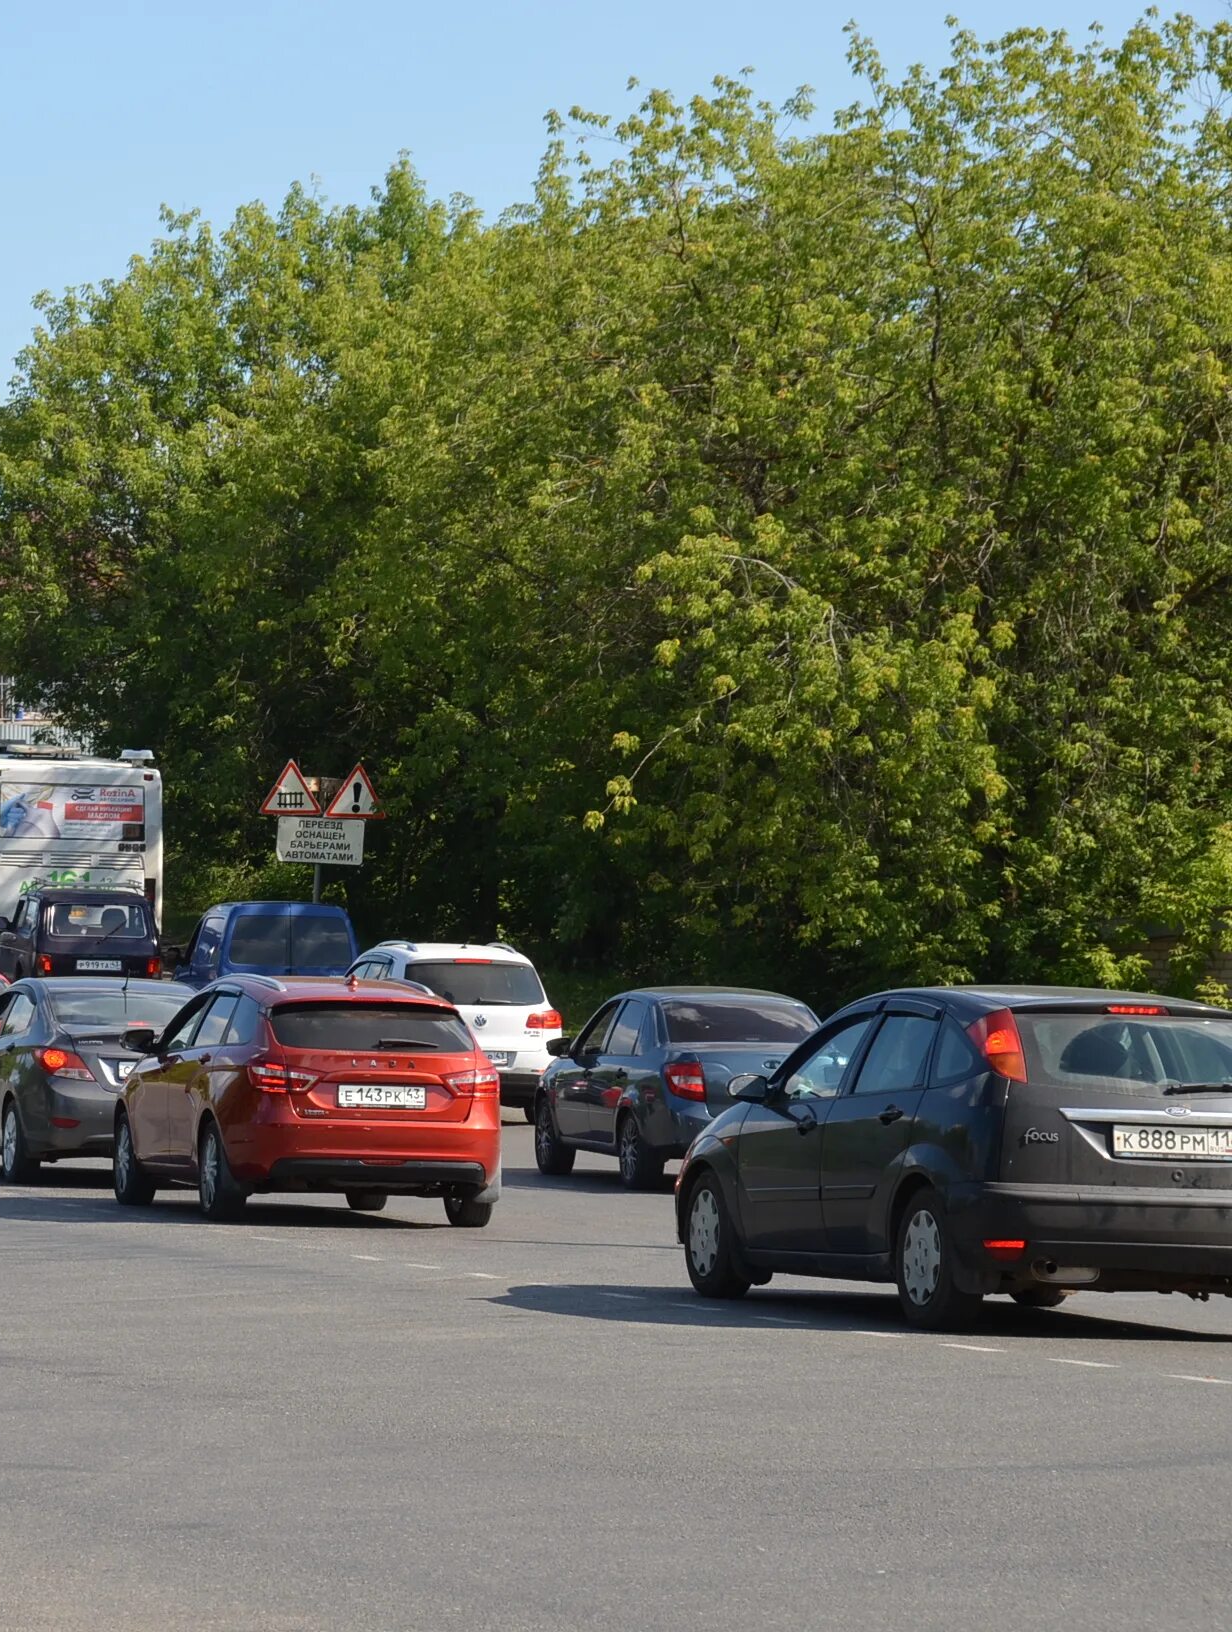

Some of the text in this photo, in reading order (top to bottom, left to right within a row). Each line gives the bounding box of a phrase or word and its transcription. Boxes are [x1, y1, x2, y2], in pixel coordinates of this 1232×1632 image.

[298, 820, 343, 831] ПЕРЕЕЗД
[295, 830, 346, 841] ОСНАЩЕН
[290, 840, 351, 851] БАРЬЕРАМИ
[285, 851, 353, 862] АВТОМАТАМИ
[351, 1059, 416, 1069] LADA
[406, 1088, 420, 1099] 43
